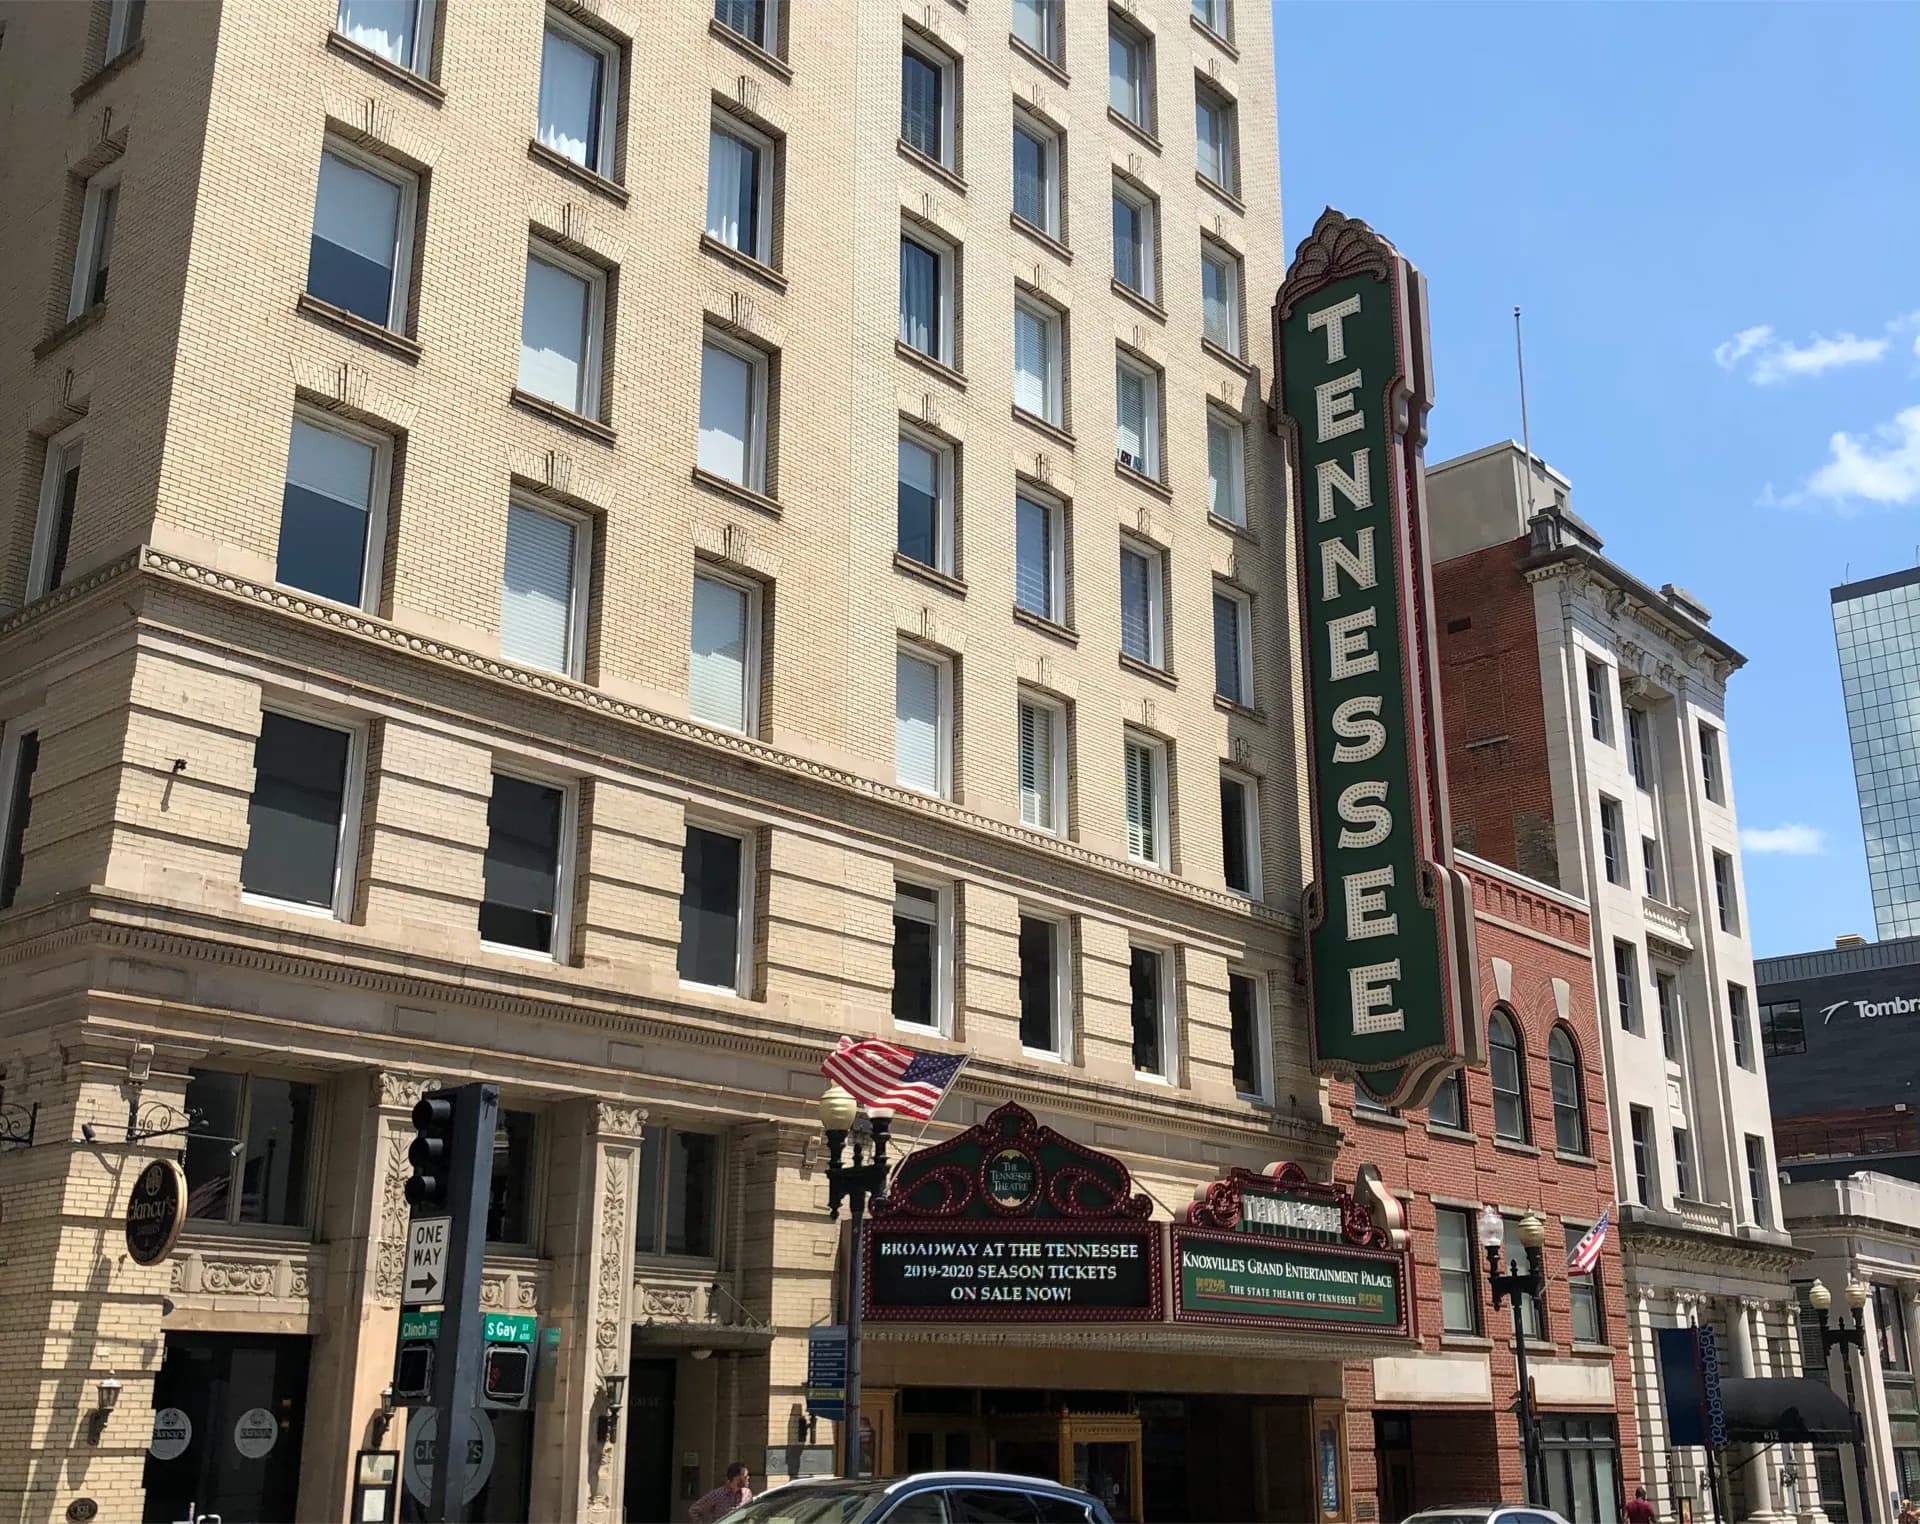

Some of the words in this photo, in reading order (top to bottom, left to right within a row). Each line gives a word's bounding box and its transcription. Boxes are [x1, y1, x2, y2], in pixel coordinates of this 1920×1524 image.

[1307, 293, 1405, 1036] TENNESSEE
[1853, 996, 1920, 1018] Tombr
[990, 1170, 1032, 1181] TENNESSEE
[1002, 1161, 1018, 1171] THE
[992, 1181, 1028, 1191] THEATRE
[128, 1196, 176, 1222] clancy's
[1241, 1194, 1342, 1233] TENNESSEE
[416, 1225, 443, 1244] ONE
[413, 1247, 441, 1267] WAY
[881, 1243, 979, 1256] BROADWAY
[983, 1243, 1005, 1257] AT
[1008, 1243, 1041, 1257] THE
[1044, 1243, 1139, 1258] TENNESSEE
[903, 1264, 974, 1278] 2019-2020
[977, 1265, 1044, 1279] SEASON
[1047, 1266, 1117, 1280] TICKETS
[1183, 1251, 1245, 1273] KNOXVILLE'S
[1247, 1258, 1283, 1277] GRAND
[1285, 1262, 1358, 1284] ENTERTAINMENT
[1361, 1271, 1393, 1288] PALACE
[950, 1286, 977, 1300] ON
[981, 1287, 1023, 1301] SALE
[1026, 1287, 1071, 1301] NOW!
[1230, 1285, 1245, 1295] THE
[1247, 1286, 1271, 1298] STATE
[1273, 1289, 1305, 1301] THEATRE
[1306, 1292, 1316, 1302] OF
[1318, 1293, 1356, 1305] TENNESSEE
[403, 1322, 427, 1337] Clinch
[487, 1322, 495, 1336] S
[496, 1321, 517, 1341] Gay
